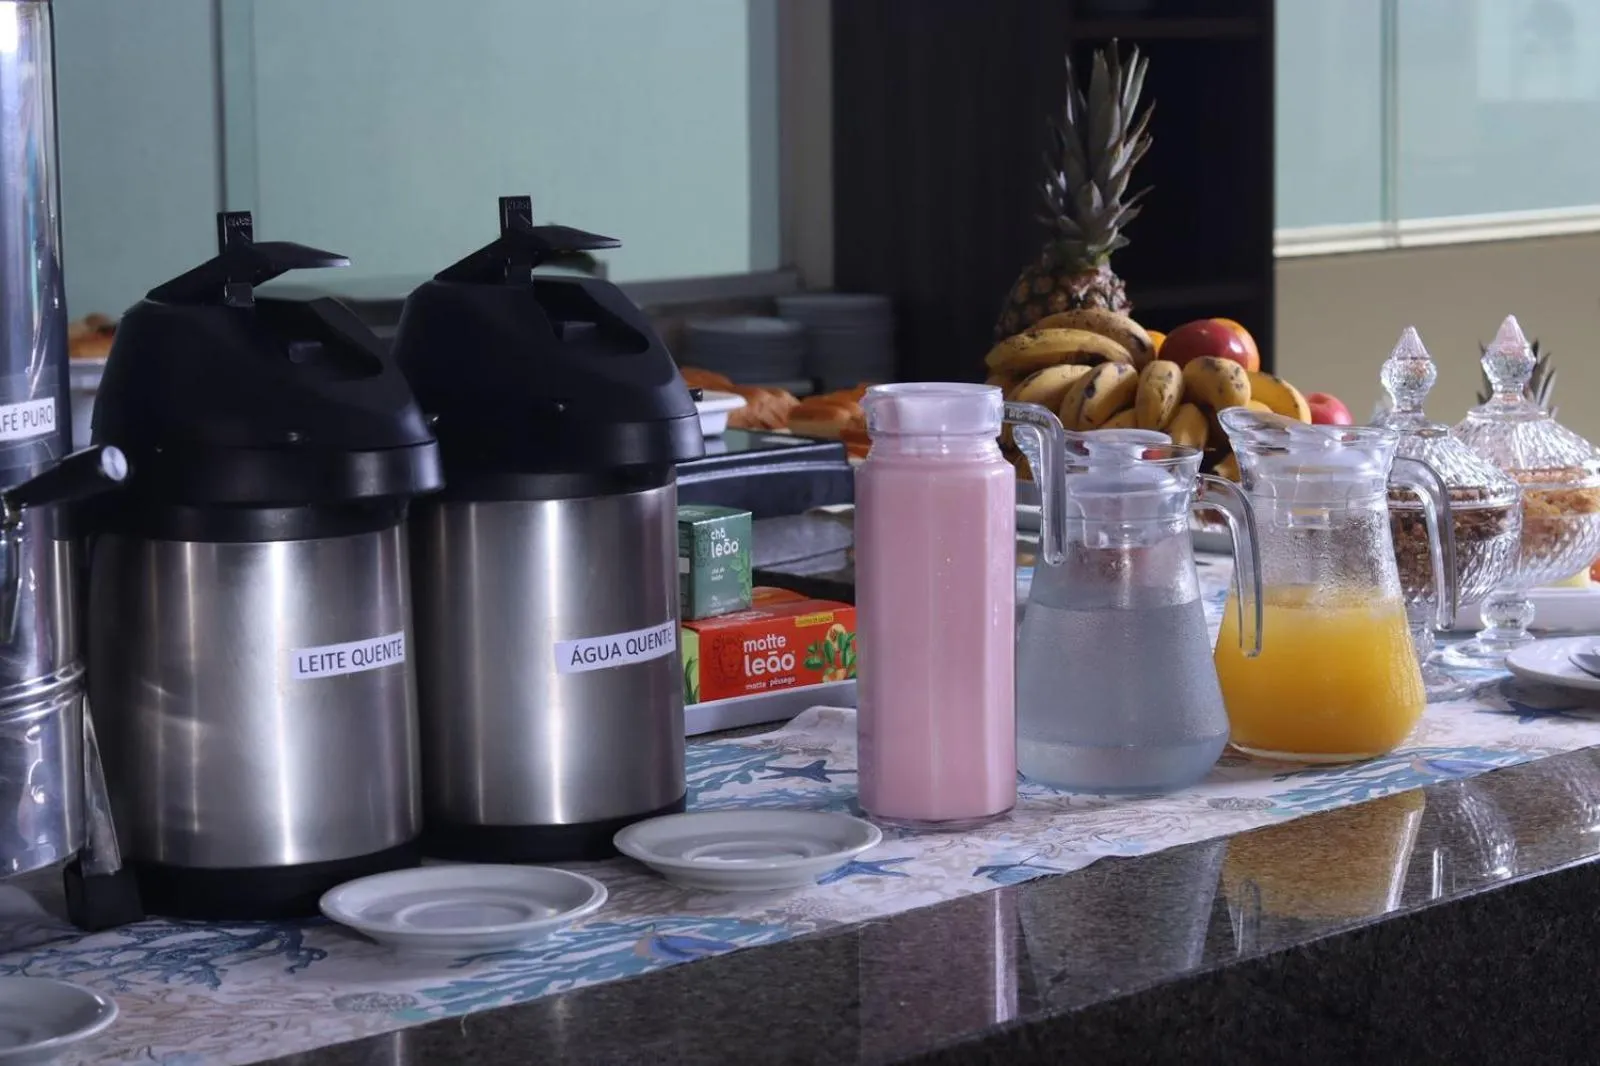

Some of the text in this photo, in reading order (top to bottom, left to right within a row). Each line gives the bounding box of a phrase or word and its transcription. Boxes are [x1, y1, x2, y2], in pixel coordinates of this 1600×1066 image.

[0, 405, 52, 432] FÉ PURO
[711, 538, 738, 558] leão
[298, 638, 403, 673] LEITE QUENTE
[570, 626, 672, 666] ÁGUA QUENTE
[743, 633, 786, 653] matte
[744, 650, 795, 677] leão
